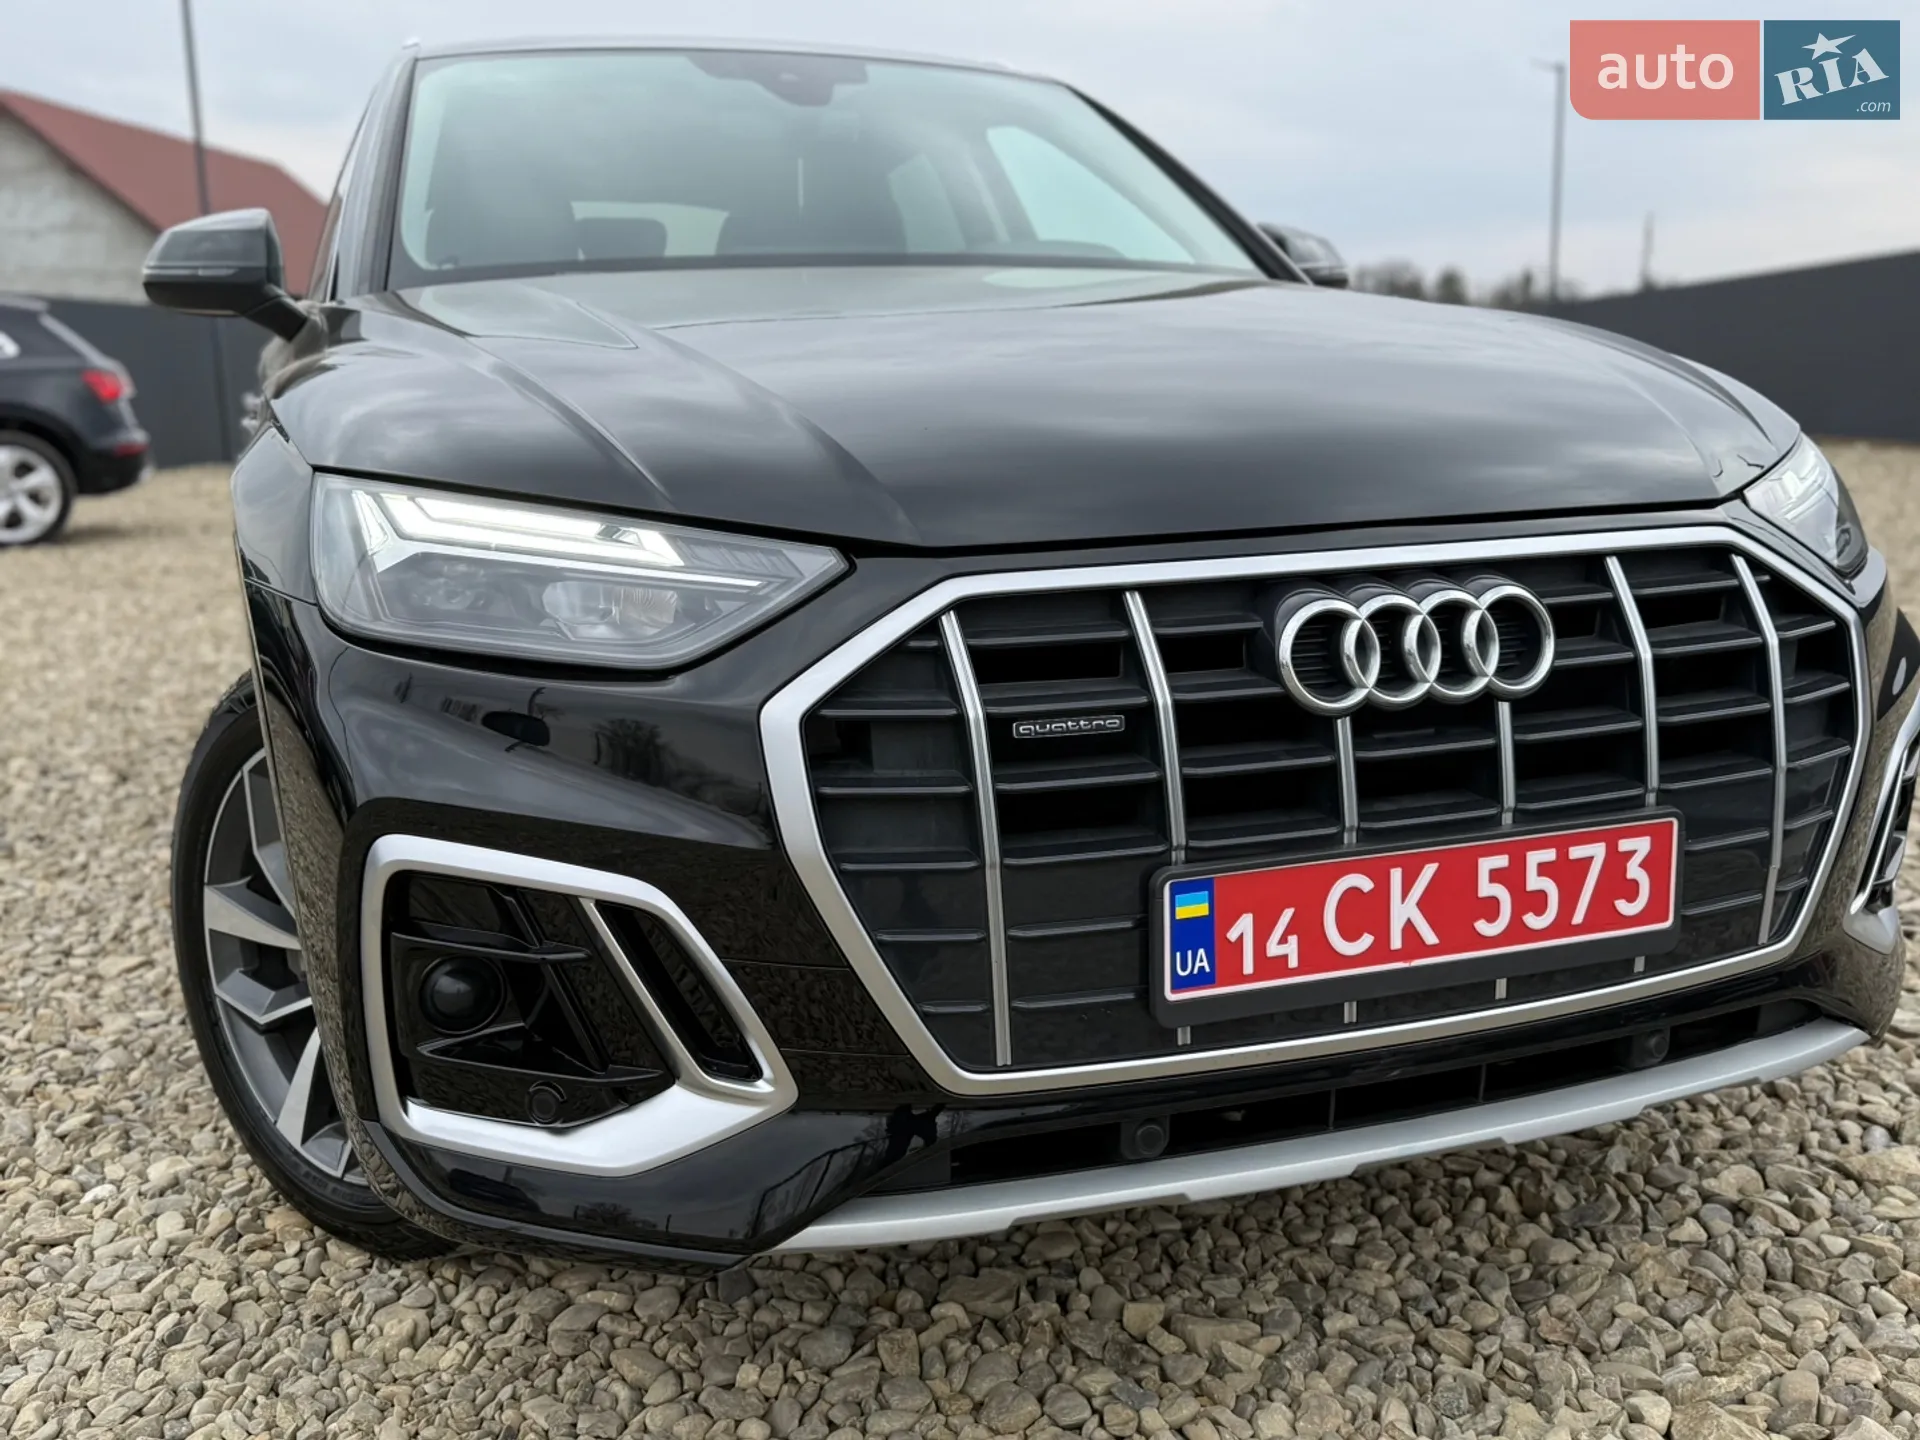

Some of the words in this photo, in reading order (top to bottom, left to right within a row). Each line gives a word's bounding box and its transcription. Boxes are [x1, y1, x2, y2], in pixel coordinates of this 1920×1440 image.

[1019, 719, 1120, 736] quattro
[1226, 907, 1299, 975] 14
[1323, 862, 1440, 956] CK
[1473, 836, 1652, 938] 5573
[1175, 948, 1210, 977] UA
